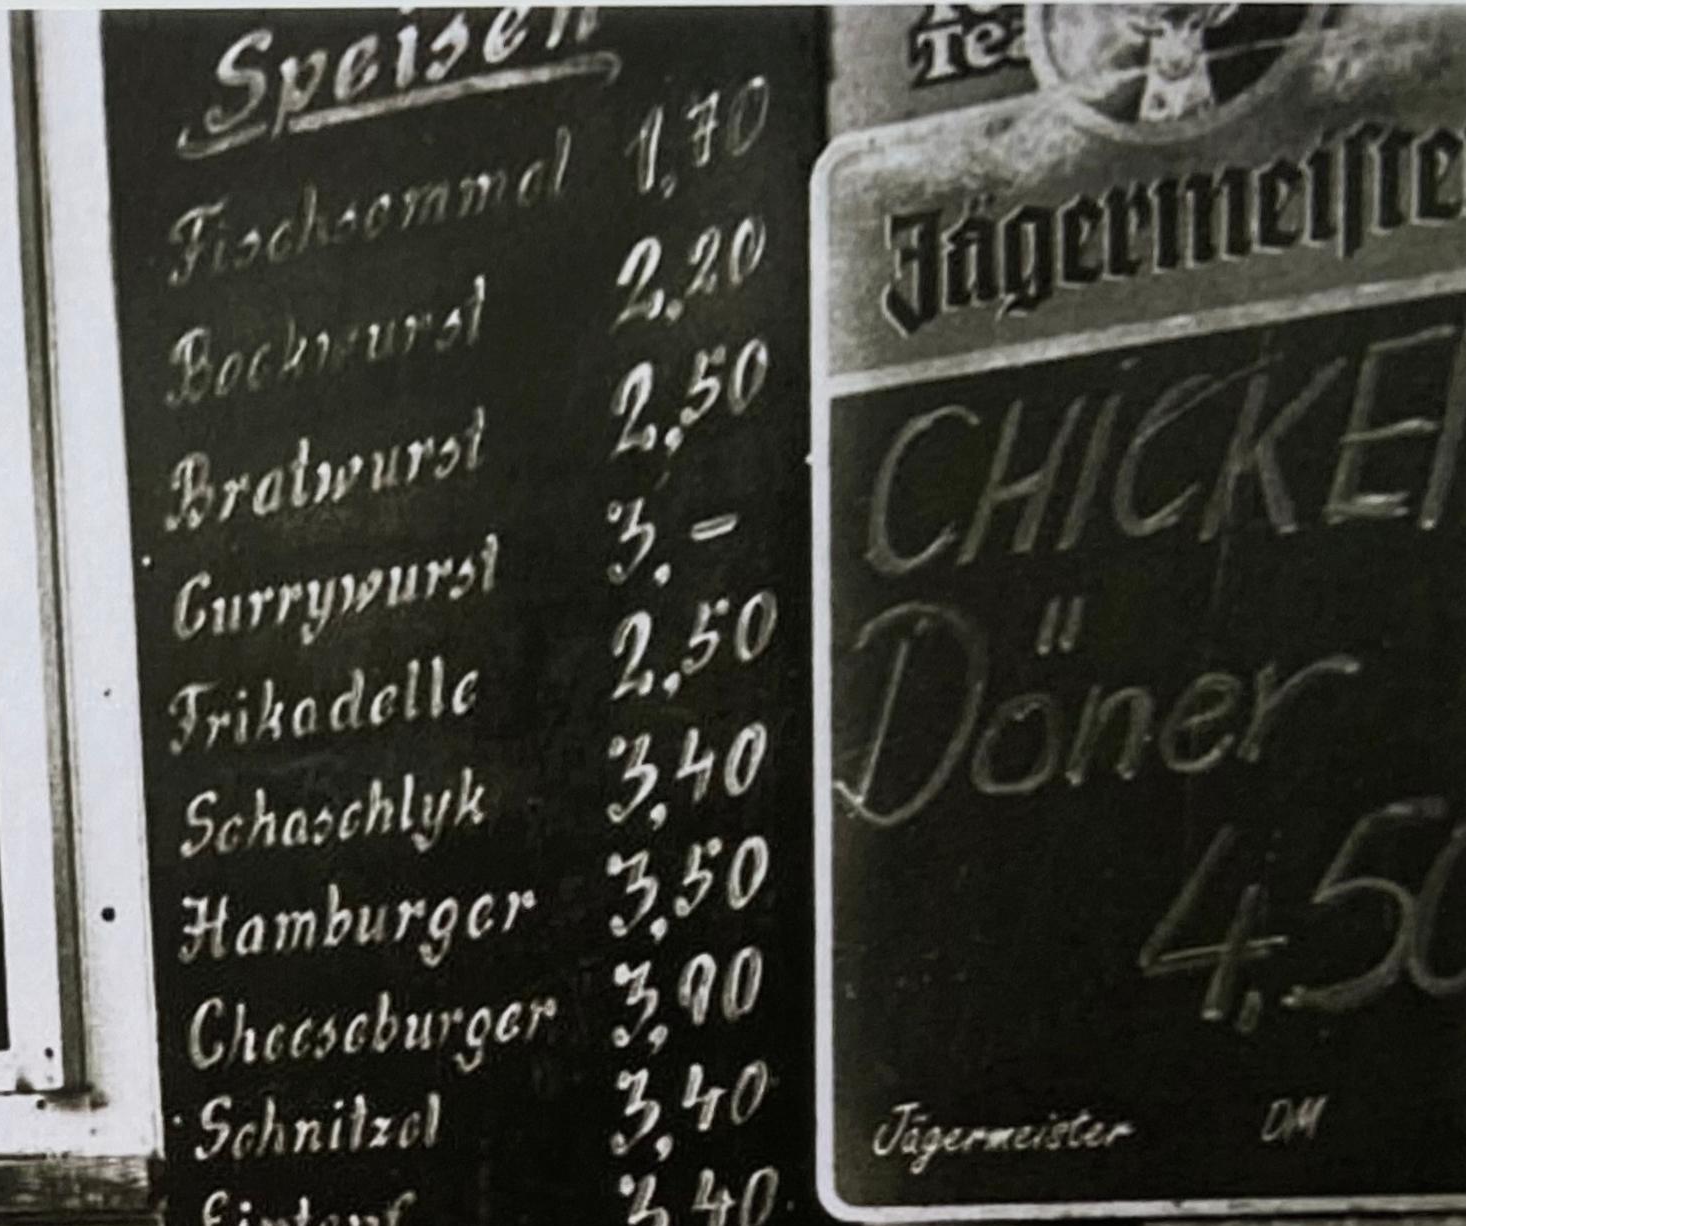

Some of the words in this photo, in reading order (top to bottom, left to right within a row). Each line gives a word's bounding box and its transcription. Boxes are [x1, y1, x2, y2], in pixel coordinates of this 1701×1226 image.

[205, 7, 598, 141] Speisen
[624, 75, 769, 200] 1,70
[881, 121, 1465, 339] Jägermeiste
[165, 274, 486, 407] Bockwurst
[612, 215, 766, 325] 2,20
[165, 405, 486, 530] Bratwurst
[612, 338, 768, 458] 2,50
[172, 533, 498, 645] Currywurst
[168, 656, 478, 754] Frikadelle
[612, 590, 778, 698] 2,50
[834, 596, 1360, 827] Döner
[180, 767, 485, 857] Schaschlyk
[607, 721, 767, 830] 3,40
[178, 883, 536, 966] Hamburger
[607, 835, 768, 940] 3,50
[188, 992, 556, 1072] Cheeseburger
[612, 946, 764, 1053] 3,90
[195, 1092, 441, 1160] Schnitzel
[611, 1059, 768, 1160] 3,40
[873, 1101, 1136, 1174] Jägermeister
